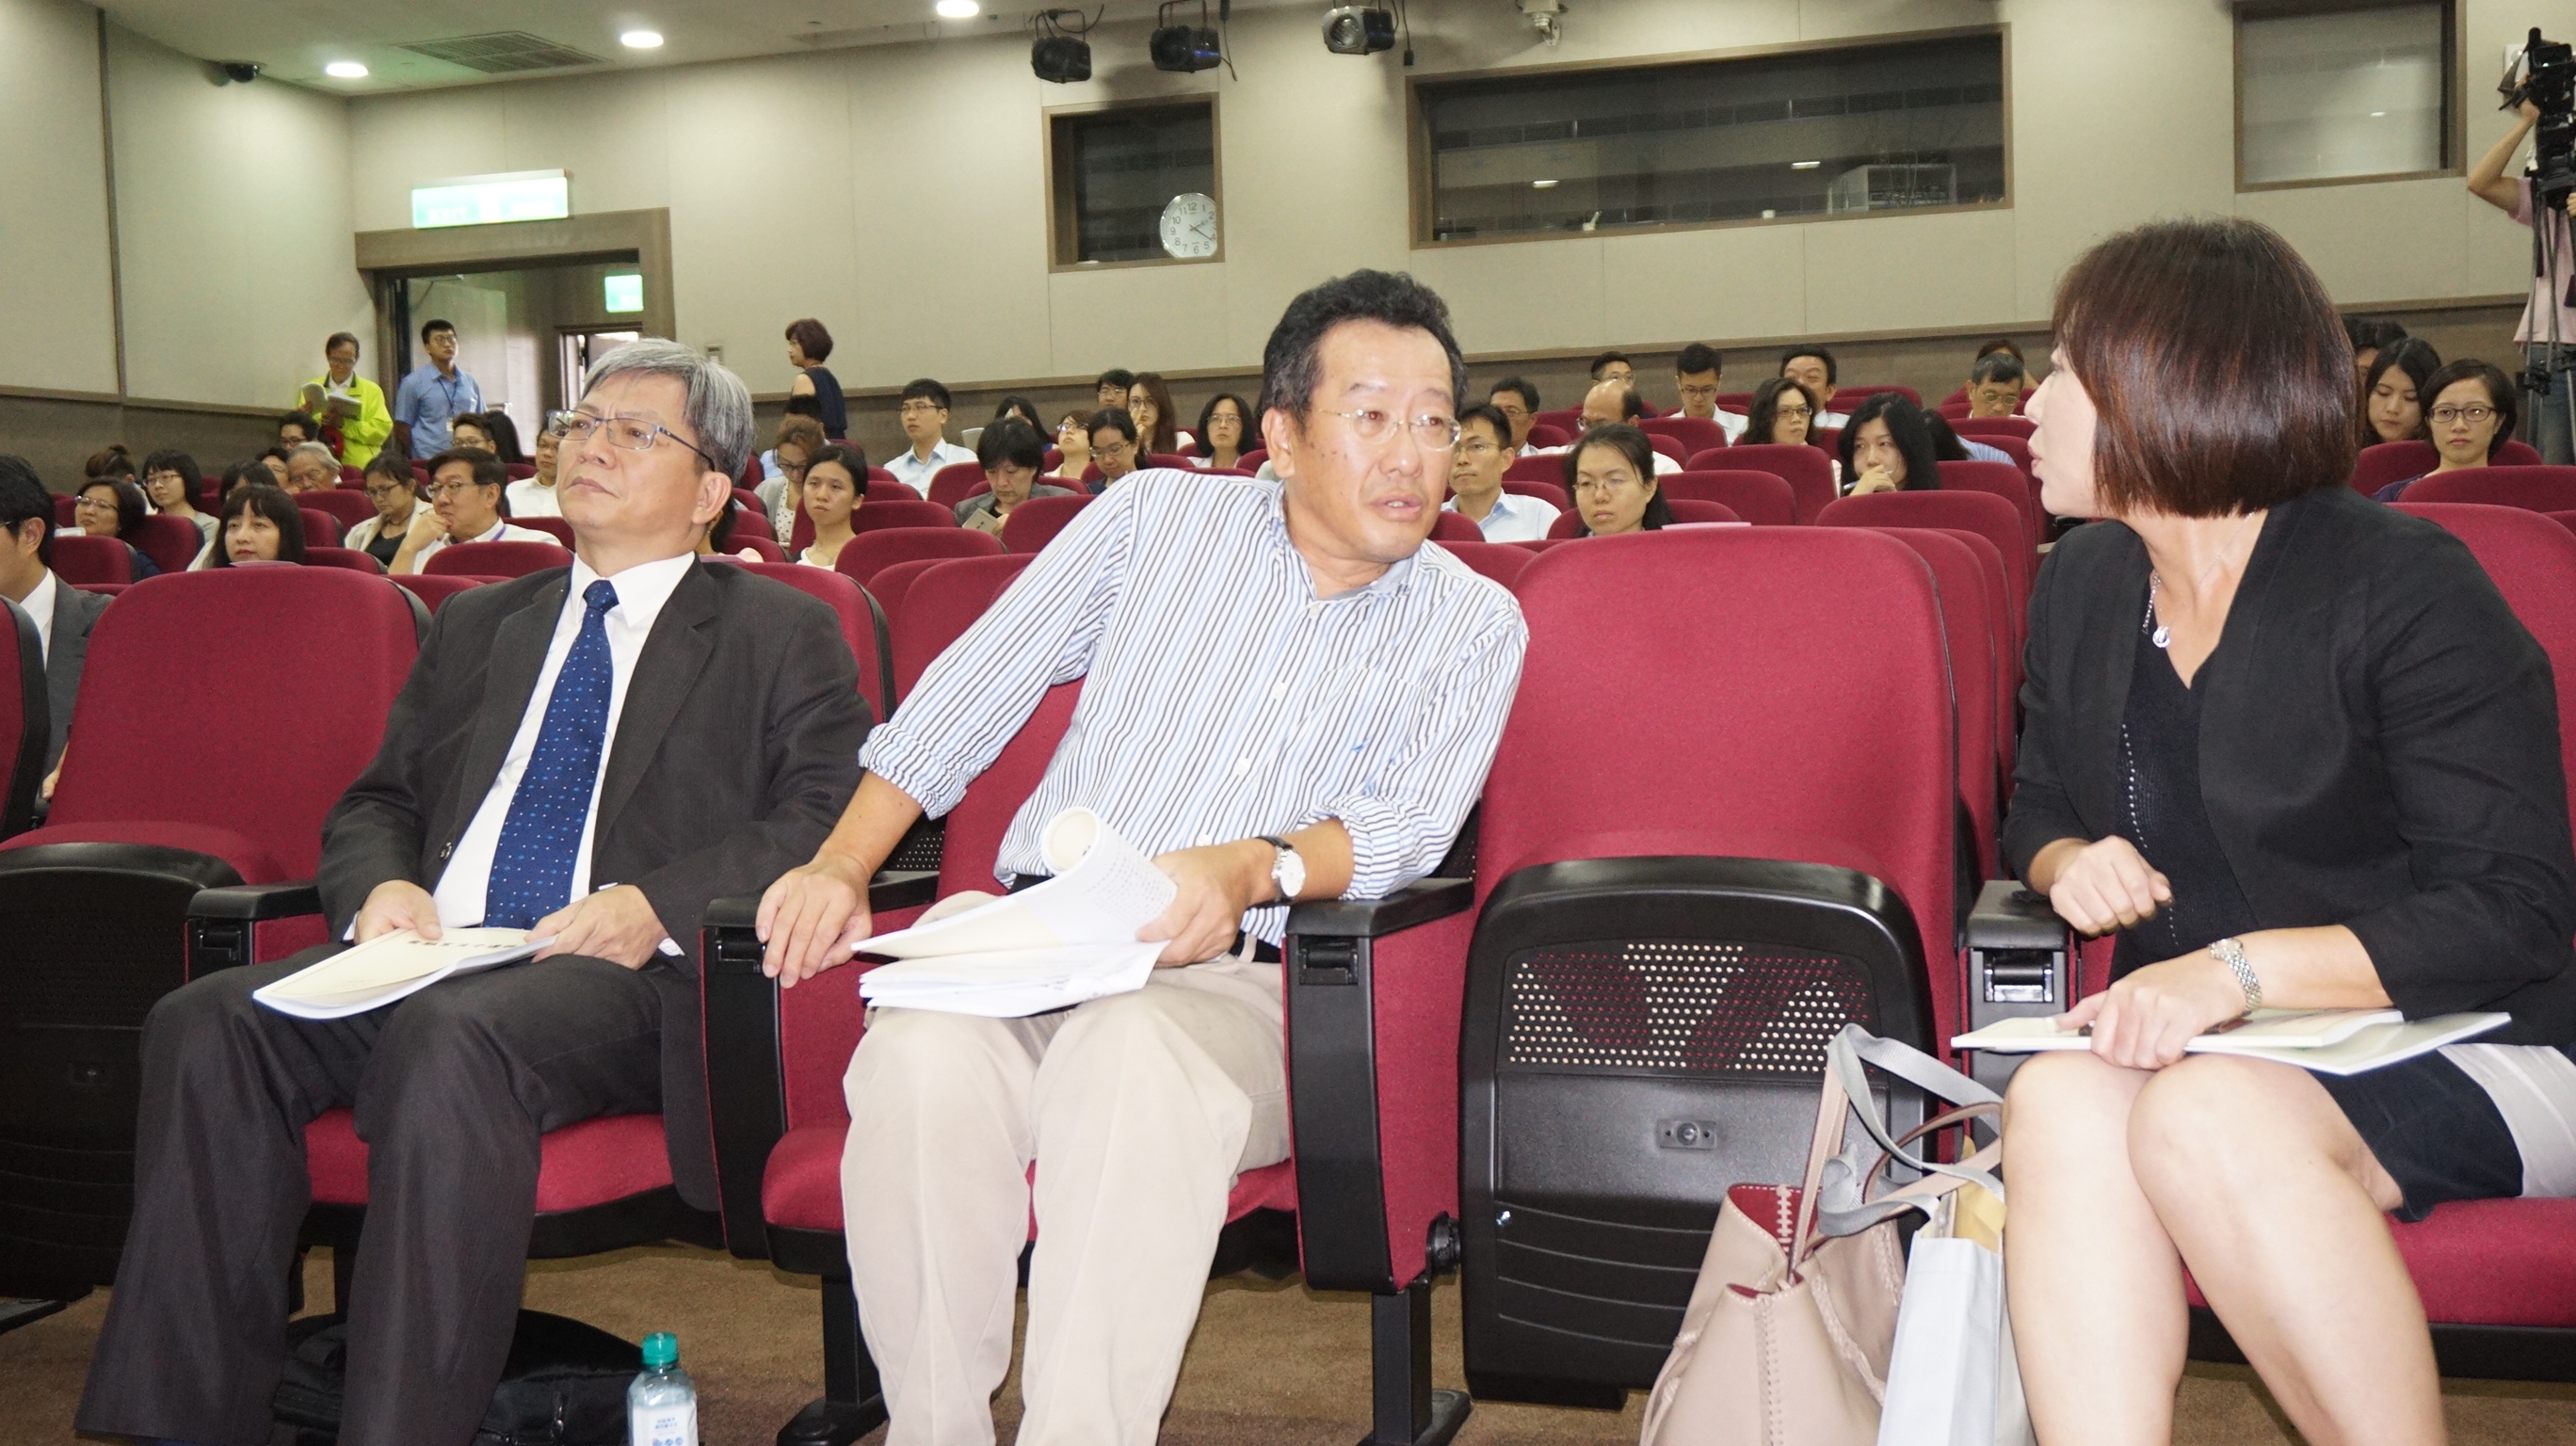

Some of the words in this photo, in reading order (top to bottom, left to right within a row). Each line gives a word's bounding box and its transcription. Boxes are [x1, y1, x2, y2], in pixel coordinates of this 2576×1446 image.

[1187, 201, 1197, 211] 12
[1208, 211, 1215, 219] 2
[1172, 217, 1181, 225] 10
[1169, 227, 1176, 235] 9
[1174, 237, 1181, 246] 8
[1203, 241, 1210, 249] 5
[1182, 244, 1188, 252] 7
[1193, 246, 1199, 254] 6
